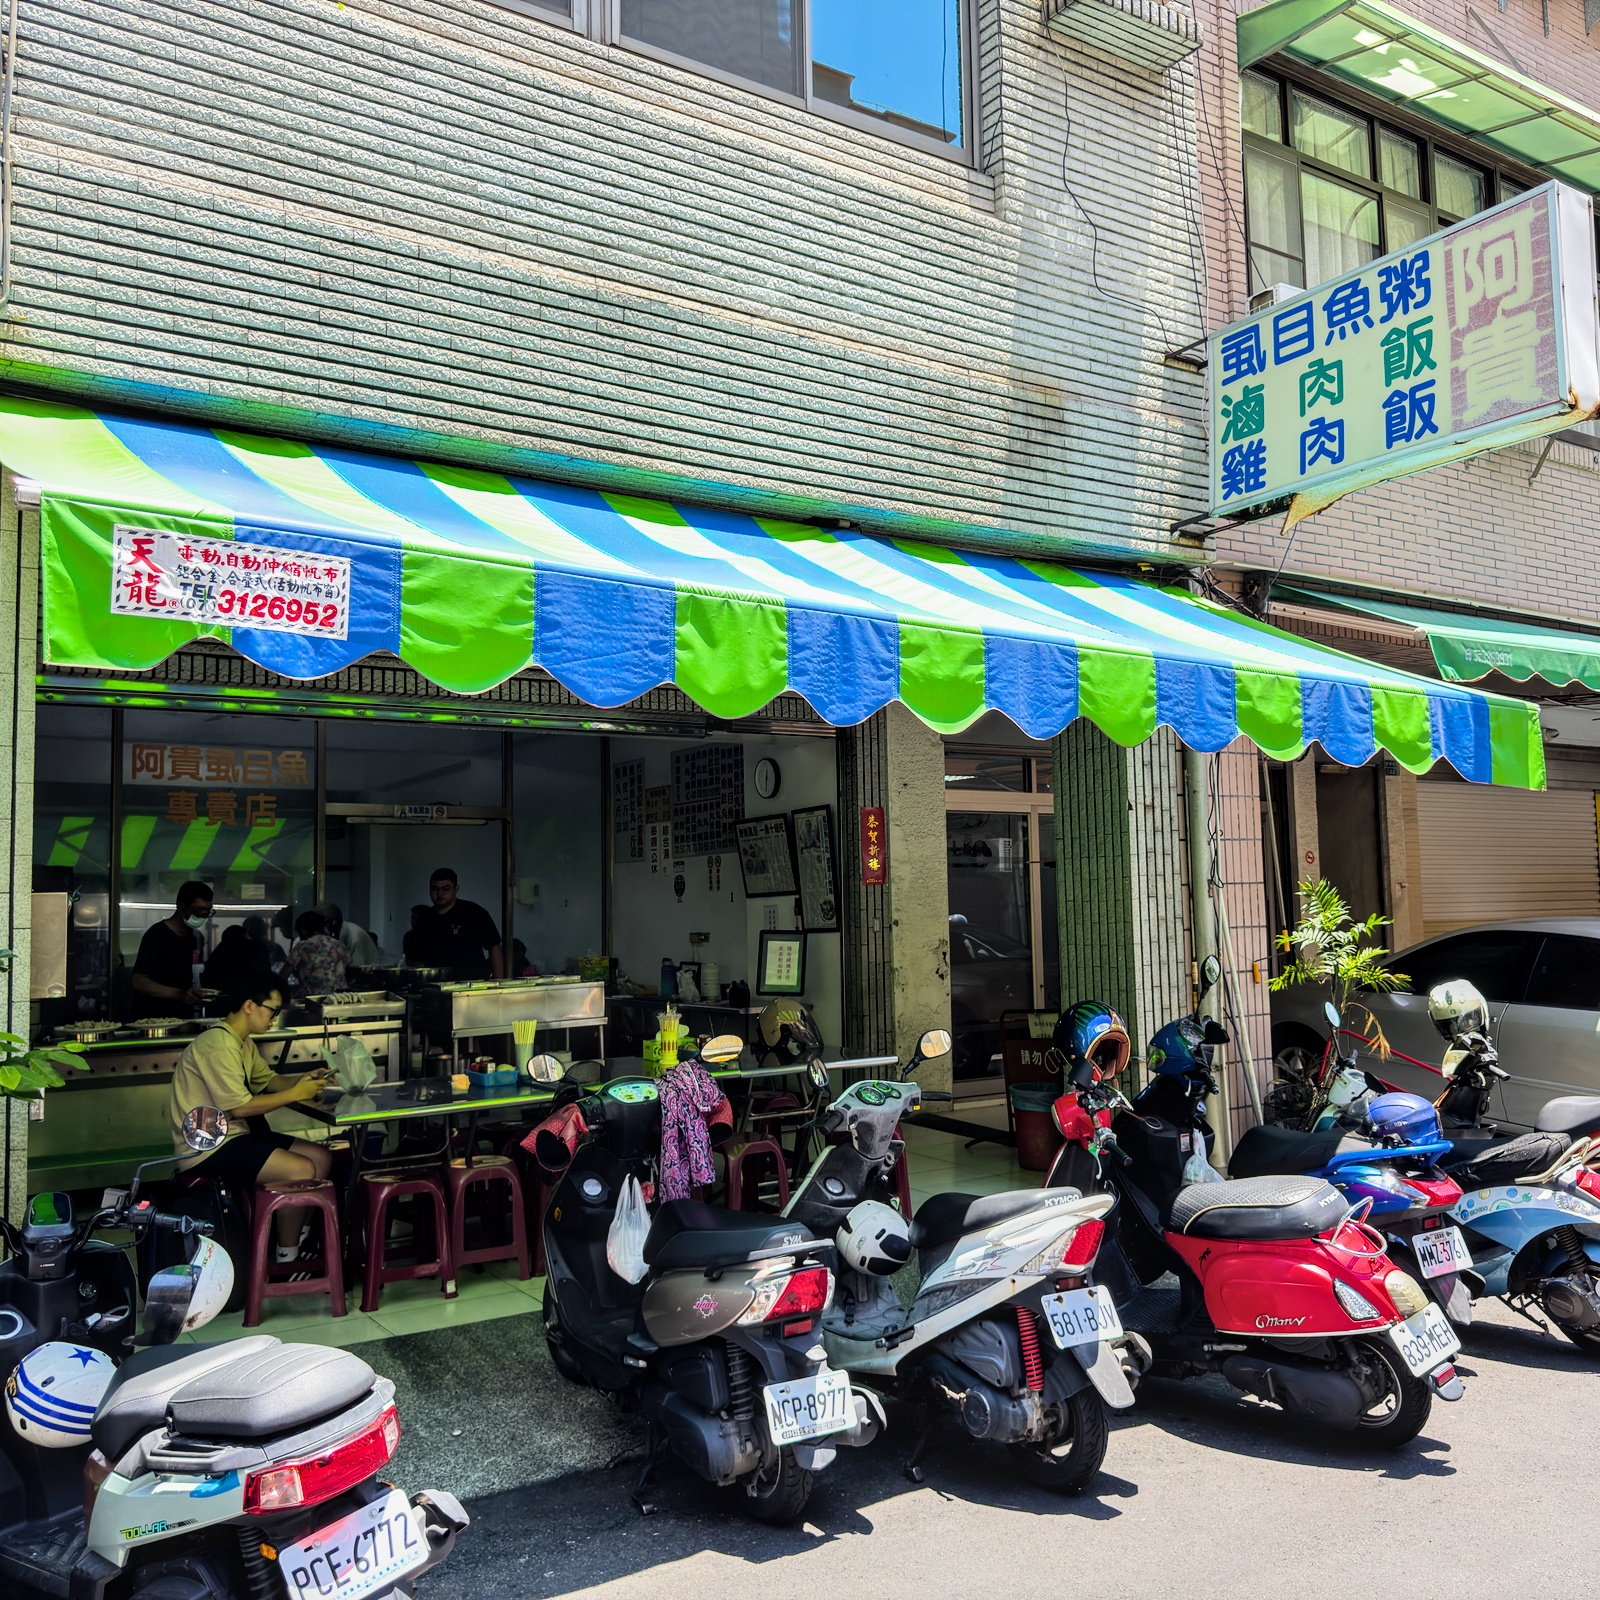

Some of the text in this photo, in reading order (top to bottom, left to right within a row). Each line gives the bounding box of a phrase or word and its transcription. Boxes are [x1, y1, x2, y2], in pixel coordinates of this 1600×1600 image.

[1221, 249, 1432, 387] 虱目魚粥
[1451, 202, 1544, 421] 阿貴
[1221, 314, 1437, 445] 滷肉飯
[1221, 378, 1439, 501] 雞肉飯
[123, 538, 167, 607] 天龍
[179, 581, 217, 600] TEL
[217, 589, 338, 628] 3126952
[131, 743, 309, 786] 阿貴虱目魚
[165, 789, 278, 828] 專賣店
[866, 814, 881, 871] 恭賀新禧
[1020, 1049, 1043, 1066] 請勿
[1044, 1193, 1080, 1208] KYMCO
[782, 1234, 803, 1247] SYM
[1418, 1238, 1467, 1268] MMZ-3761
[1050, 1303, 1116, 1338] 581-BJV
[1402, 1319, 1456, 1367] 839-MEH
[770, 1386, 846, 1431] NCP-8977
[120, 1519, 168, 1540] DOLLAR
[291, 1511, 418, 1600] PCE-6772
